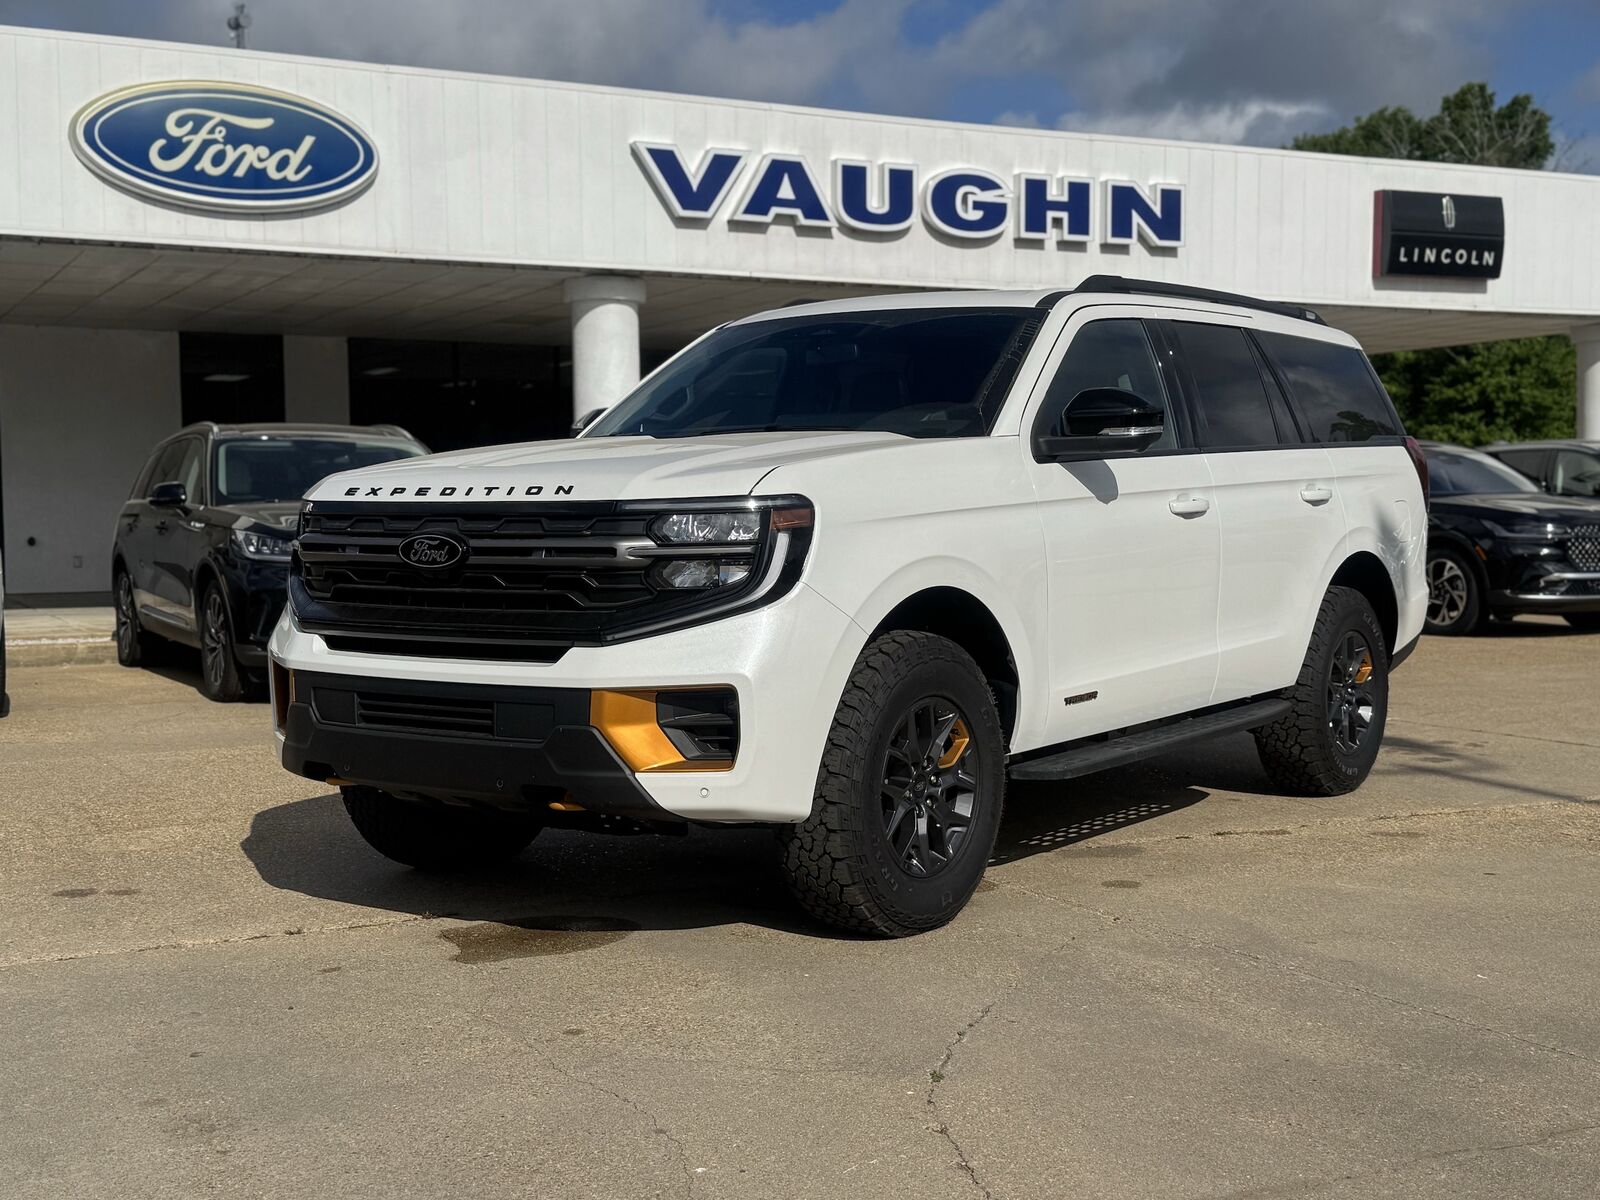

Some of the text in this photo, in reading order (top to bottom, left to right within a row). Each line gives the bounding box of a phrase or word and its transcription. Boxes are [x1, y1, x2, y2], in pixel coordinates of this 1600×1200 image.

[148, 108, 317, 182] Ford
[634, 142, 1187, 248] VAUGHN
[1398, 246, 1495, 267] LINCOLN
[344, 485, 575, 497] EXPEDITION
[410, 539, 449, 562] Ford
